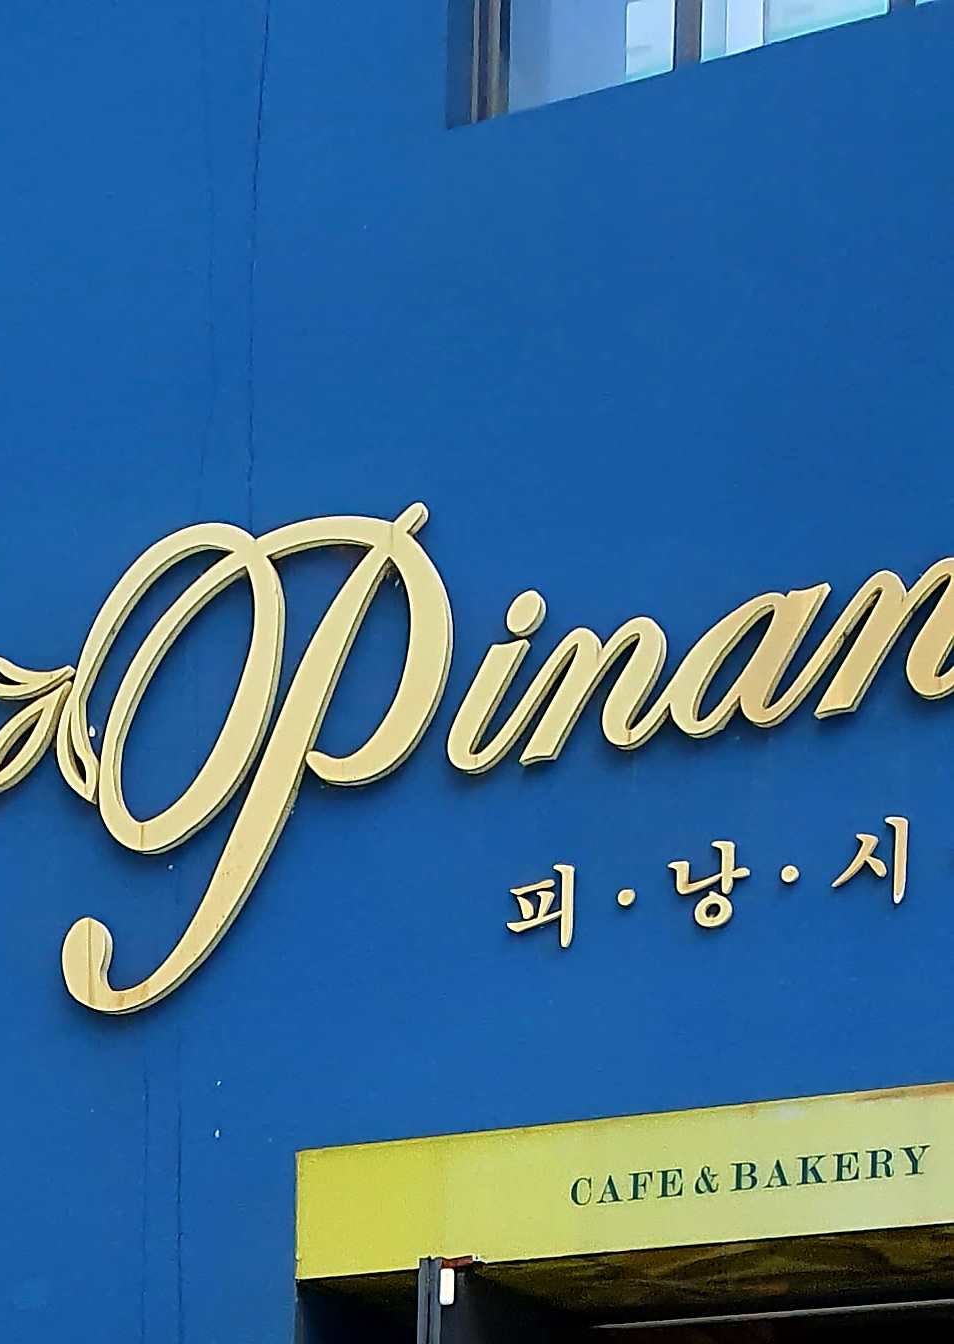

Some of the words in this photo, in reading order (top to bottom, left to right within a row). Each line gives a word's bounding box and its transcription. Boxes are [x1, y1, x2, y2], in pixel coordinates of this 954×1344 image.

[570, 1168, 684, 1207] CAFE
[694, 1165, 720, 1195] &
[730, 1144, 931, 1192] BAKERY
